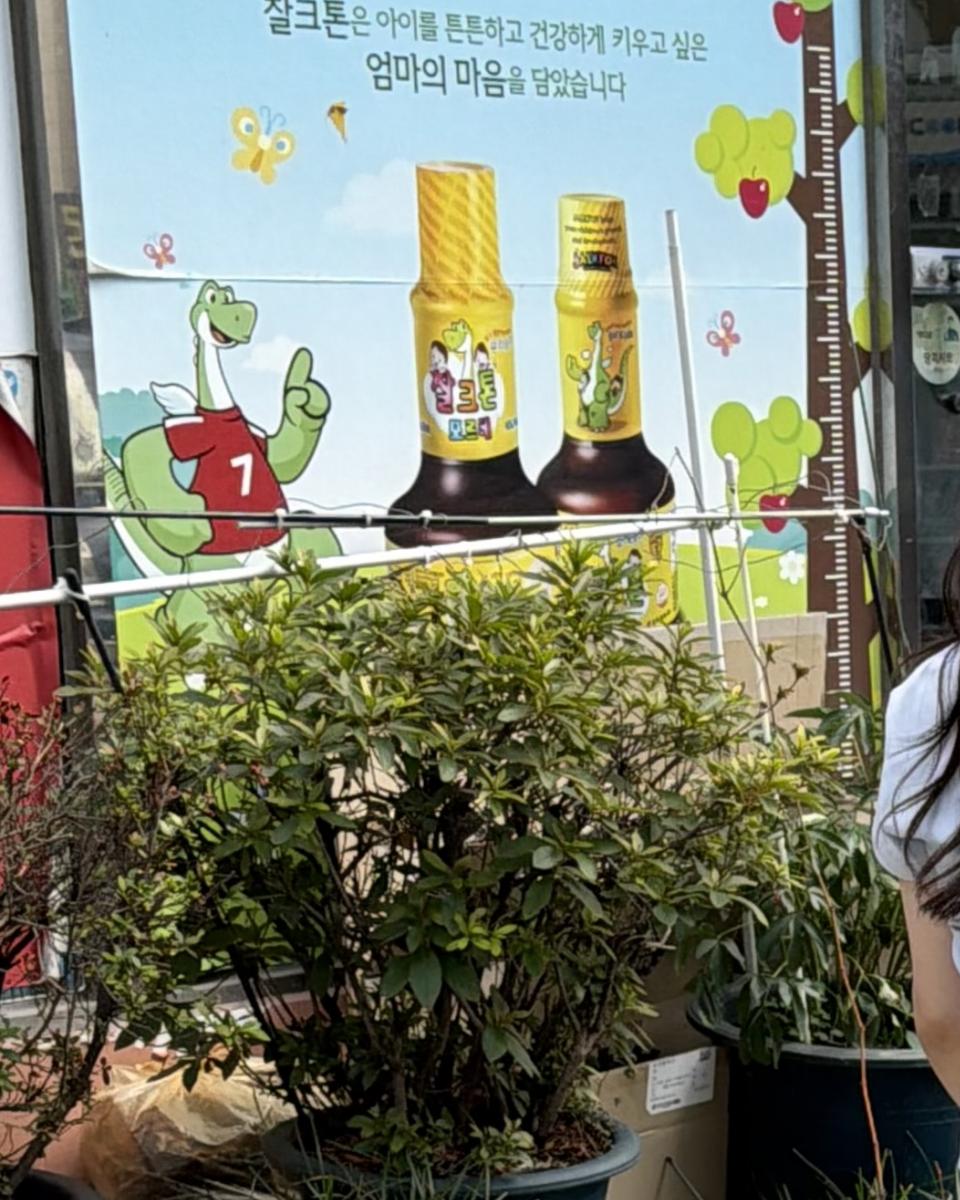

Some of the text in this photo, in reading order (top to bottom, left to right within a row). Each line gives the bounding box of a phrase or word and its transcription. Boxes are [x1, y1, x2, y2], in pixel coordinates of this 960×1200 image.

[264, 0, 709, 61] 잘크톤은 아이를 튼튼하고 건강하게 키우고 싶은
[366, 51, 627, 102] 엄마의 마음을 담았습니다
